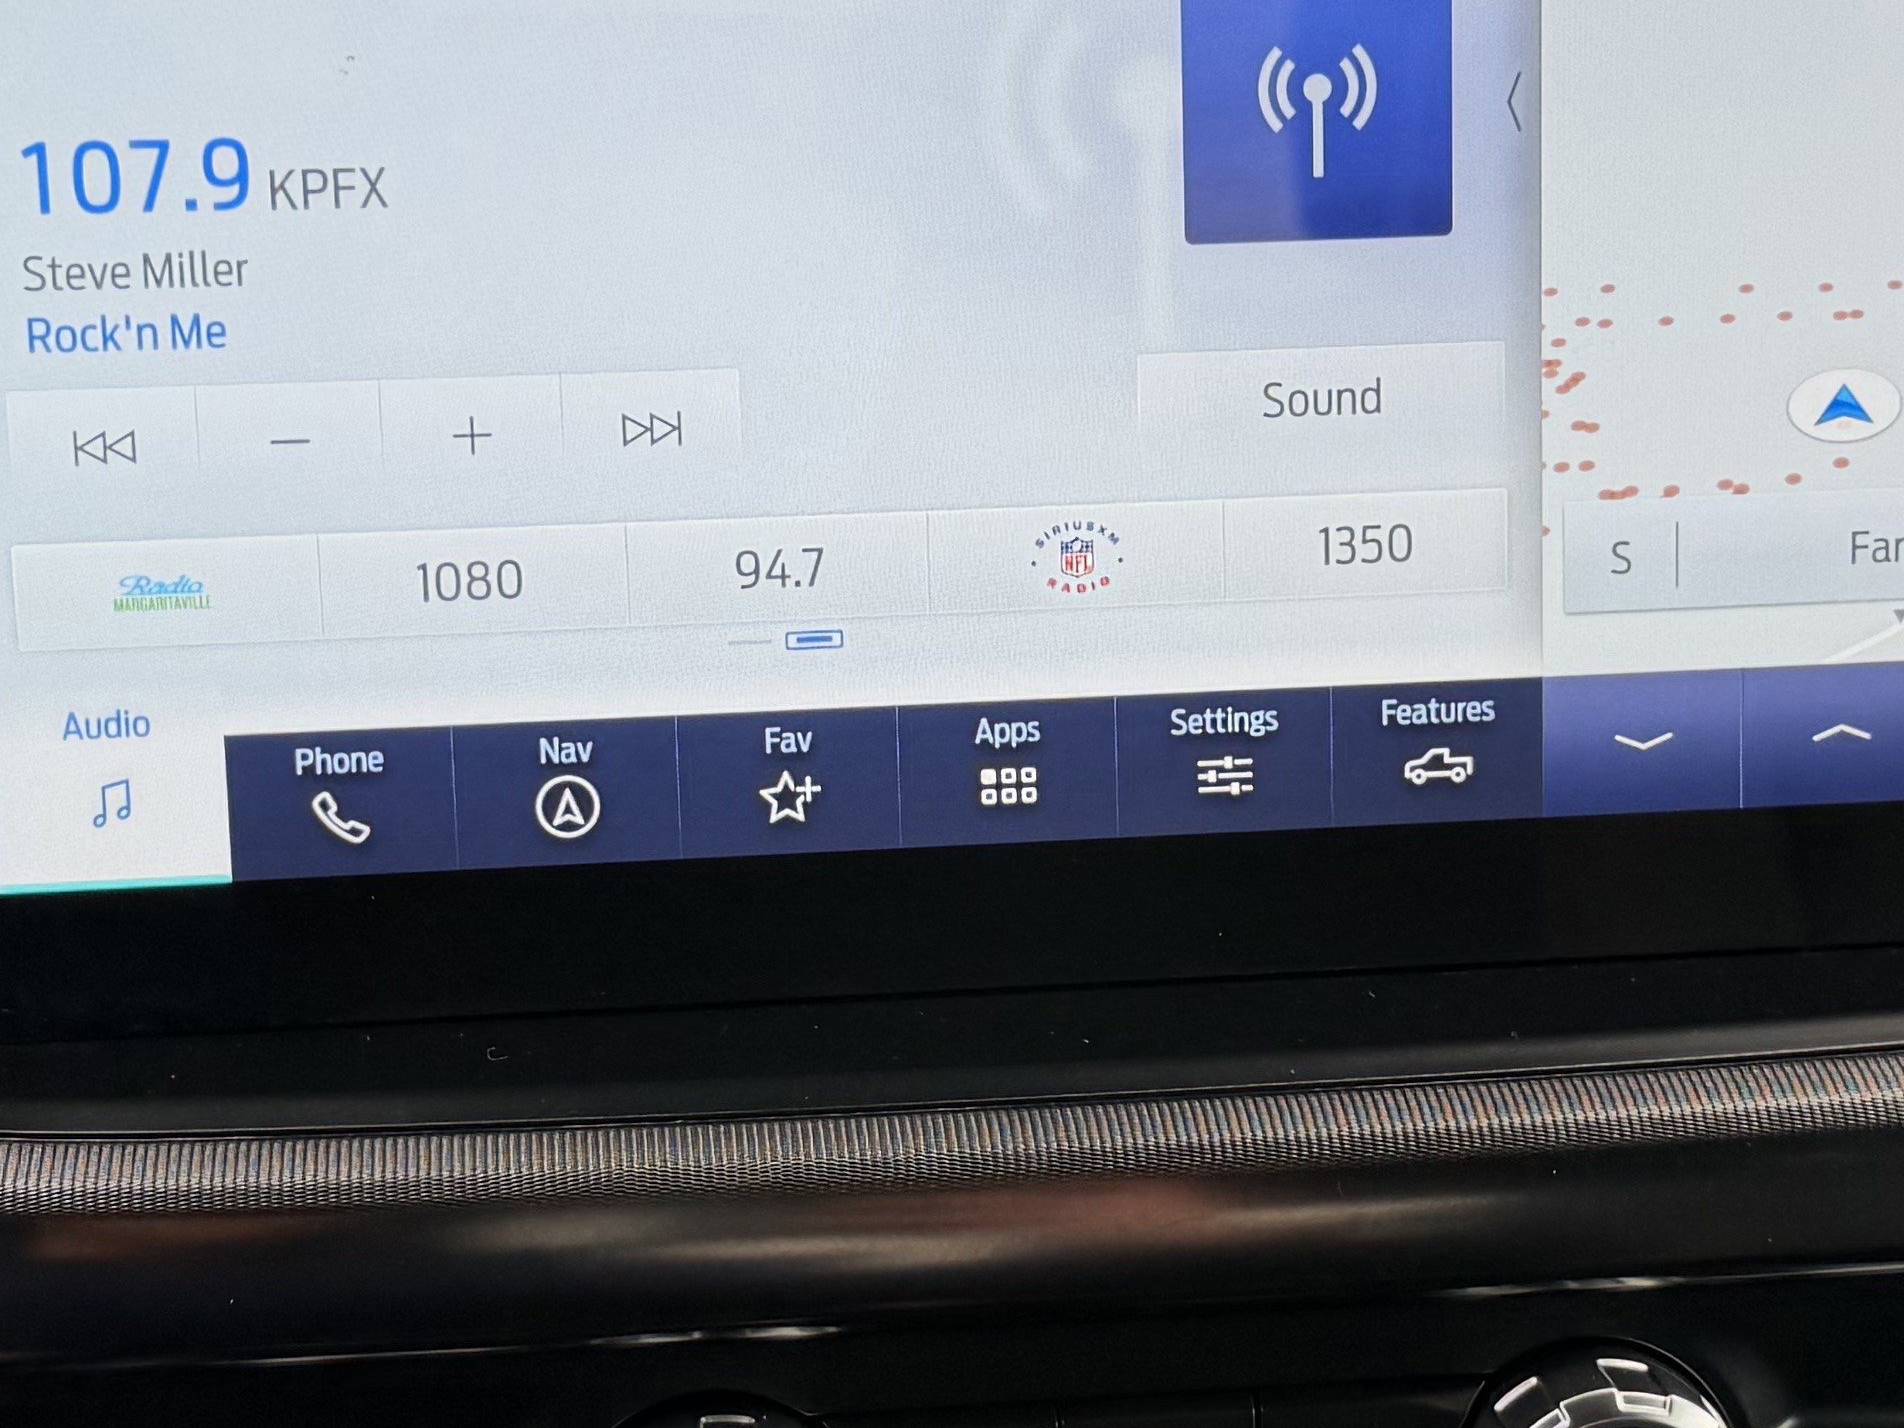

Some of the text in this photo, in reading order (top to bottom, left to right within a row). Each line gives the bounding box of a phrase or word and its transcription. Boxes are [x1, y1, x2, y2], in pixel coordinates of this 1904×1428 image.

[20, 137, 389, 215] 107.9 KPFX
[22, 250, 248, 292] Steve Miller
[26, 313, 228, 354] Rock'n Me
[1262, 377, 1383, 418] Sound
[1318, 523, 1414, 566] 1350
[1610, 539, 1633, 575] S
[416, 558, 524, 603] 1080
[734, 547, 826, 590] 94.7
[62, 710, 151, 742] Audio
[1170, 707, 1279, 739] Settings
[1381, 697, 1496, 727] Features
[539, 735, 594, 765] Nav
[765, 726, 813, 754] Fav
[975, 717, 1041, 748] Apps
[294, 747, 385, 775] Phone
